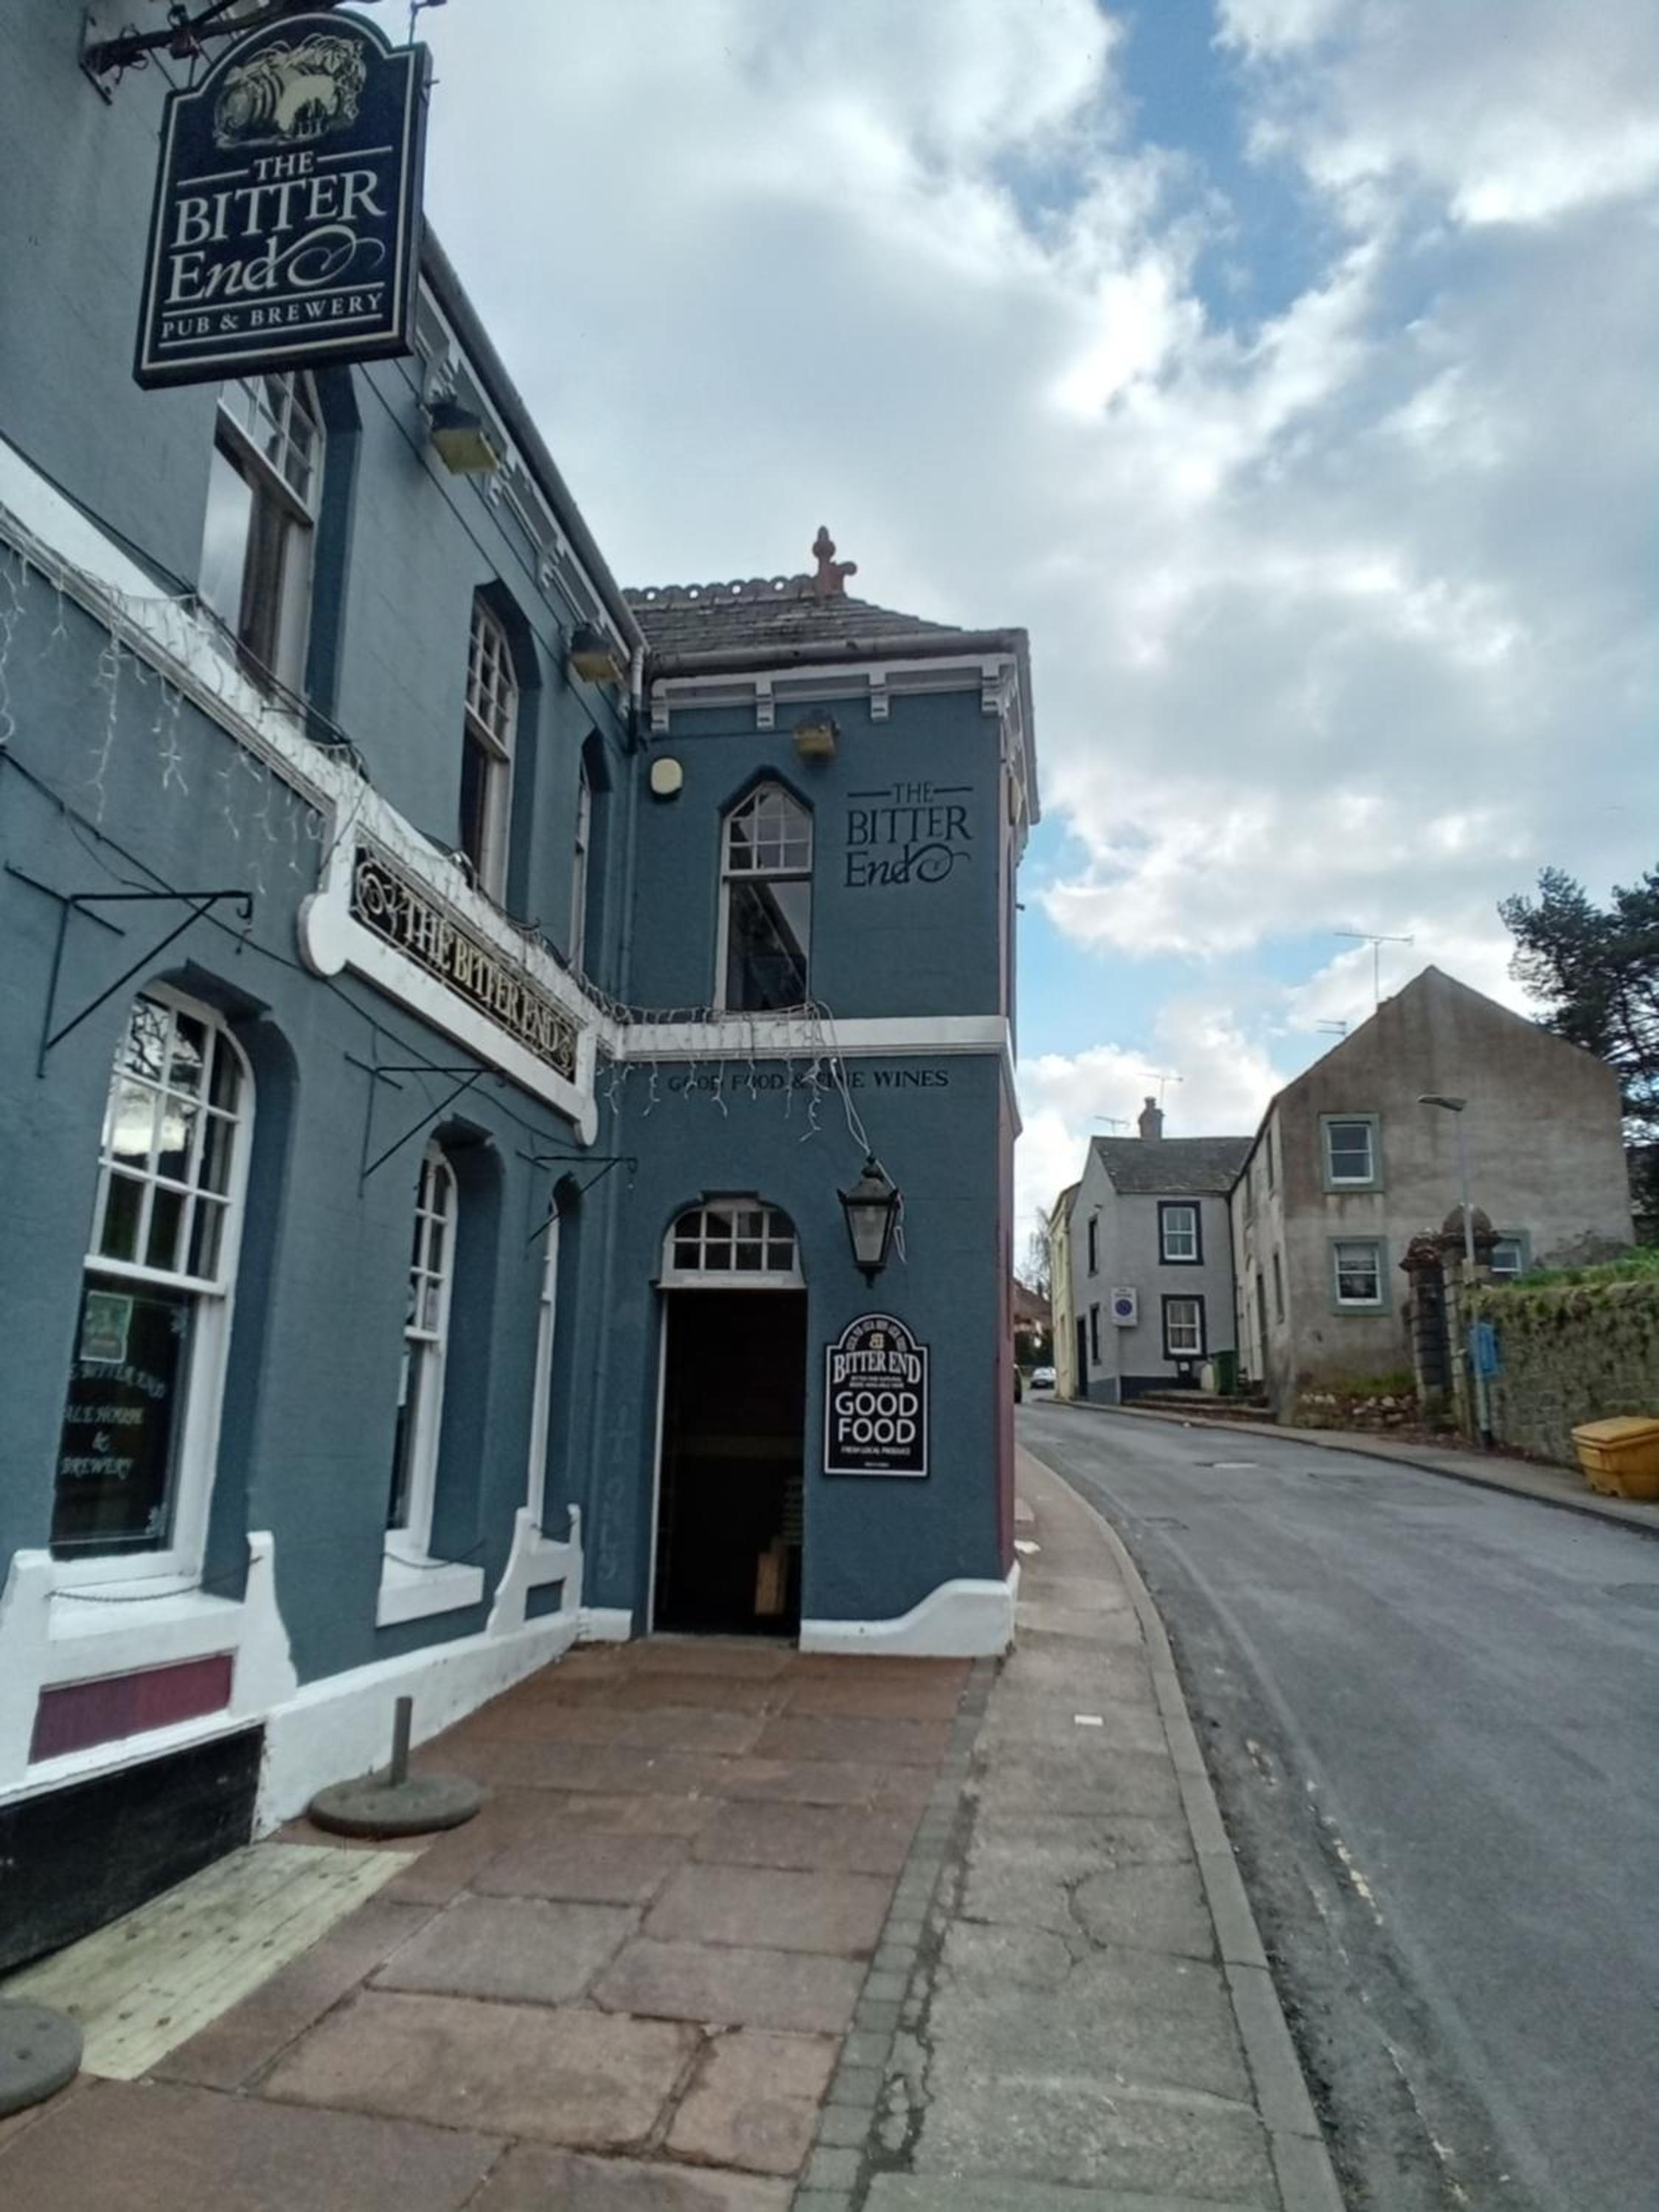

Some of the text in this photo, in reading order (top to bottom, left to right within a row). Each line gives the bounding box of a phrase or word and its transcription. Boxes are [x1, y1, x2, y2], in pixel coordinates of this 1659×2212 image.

[254, 150, 314, 181] THE
[170, 170, 388, 249] BITTER
[164, 224, 386, 305] End
[161, 292, 383, 338] PUB & BREWERY
[892, 782, 933, 804] THE
[846, 804, 973, 846] BITTER
[844, 843, 973, 888] End
[403, 891, 451, 970] THE
[453, 939, 521, 1025] BITTER
[872, 1069, 950, 1088] WINES
[833, 1351, 921, 1383] BITTER END
[835, 1391, 919, 1417] GOOD
[838, 1417, 917, 1444] FOOD
